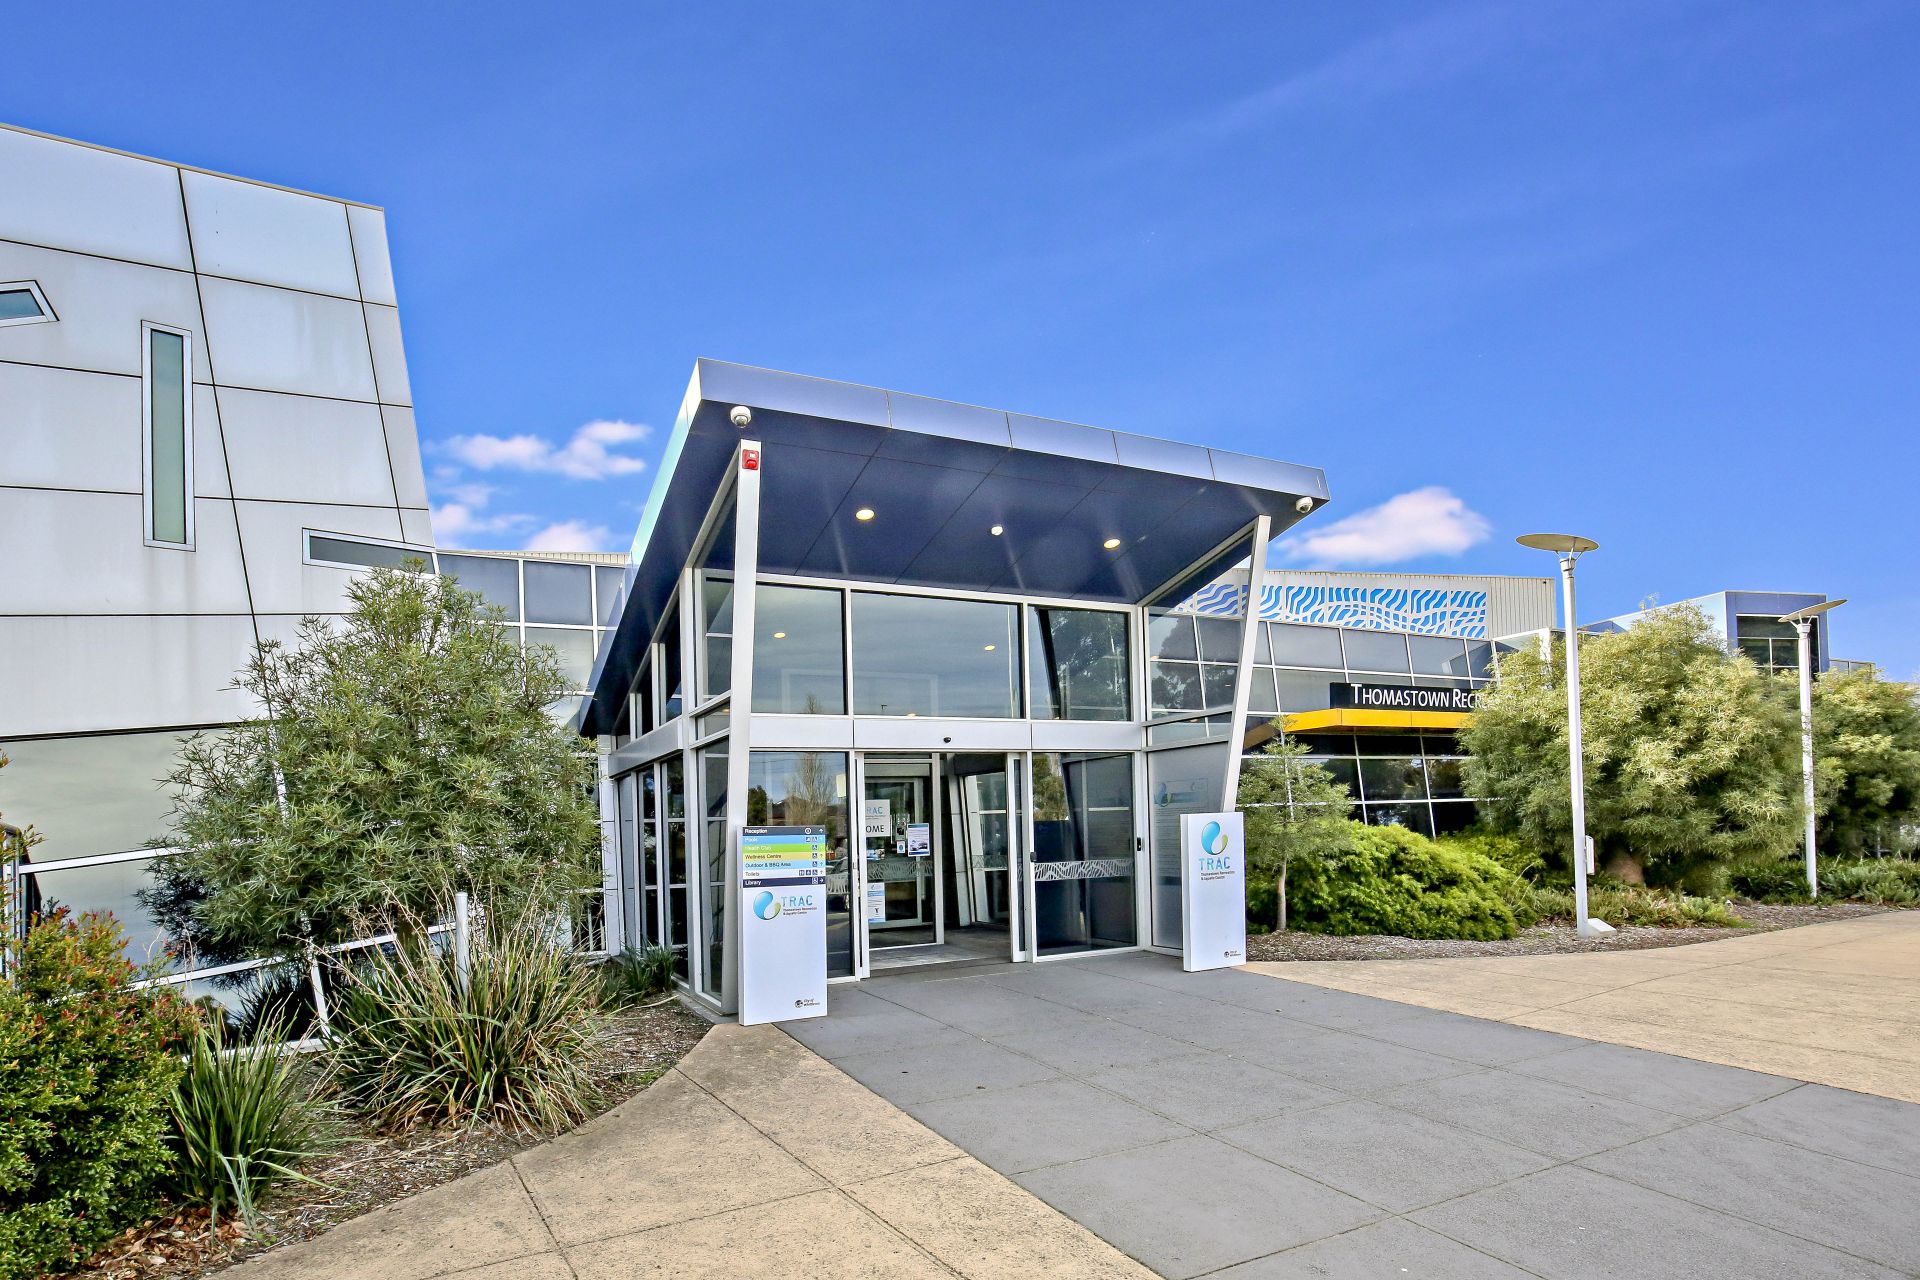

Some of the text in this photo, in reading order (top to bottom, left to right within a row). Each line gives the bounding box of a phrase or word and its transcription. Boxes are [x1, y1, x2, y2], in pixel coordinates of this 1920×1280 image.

[1351, 684, 1488, 709] THOMASTOWN RECR
[1199, 856, 1230, 870] TRAC
[781, 895, 813, 907] TRAC
